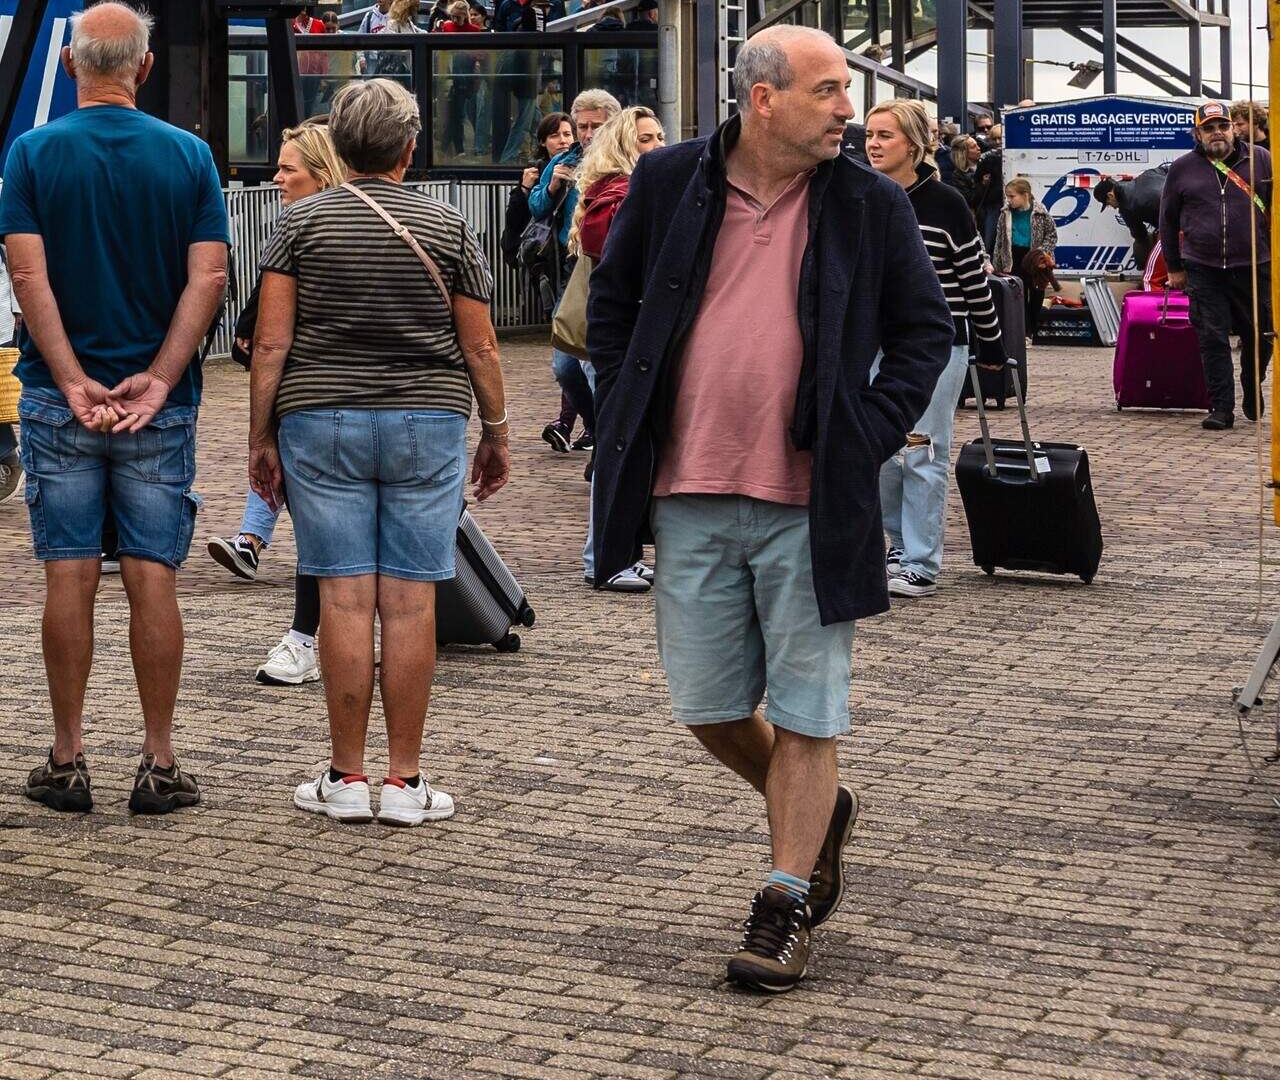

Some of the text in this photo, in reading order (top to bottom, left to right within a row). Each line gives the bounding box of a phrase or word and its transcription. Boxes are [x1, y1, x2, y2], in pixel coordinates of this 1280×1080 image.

[1030, 113, 1194, 125] GRATIS BAGAGEVERVOER
[1085, 151, 1141, 162] T-76-DHL
